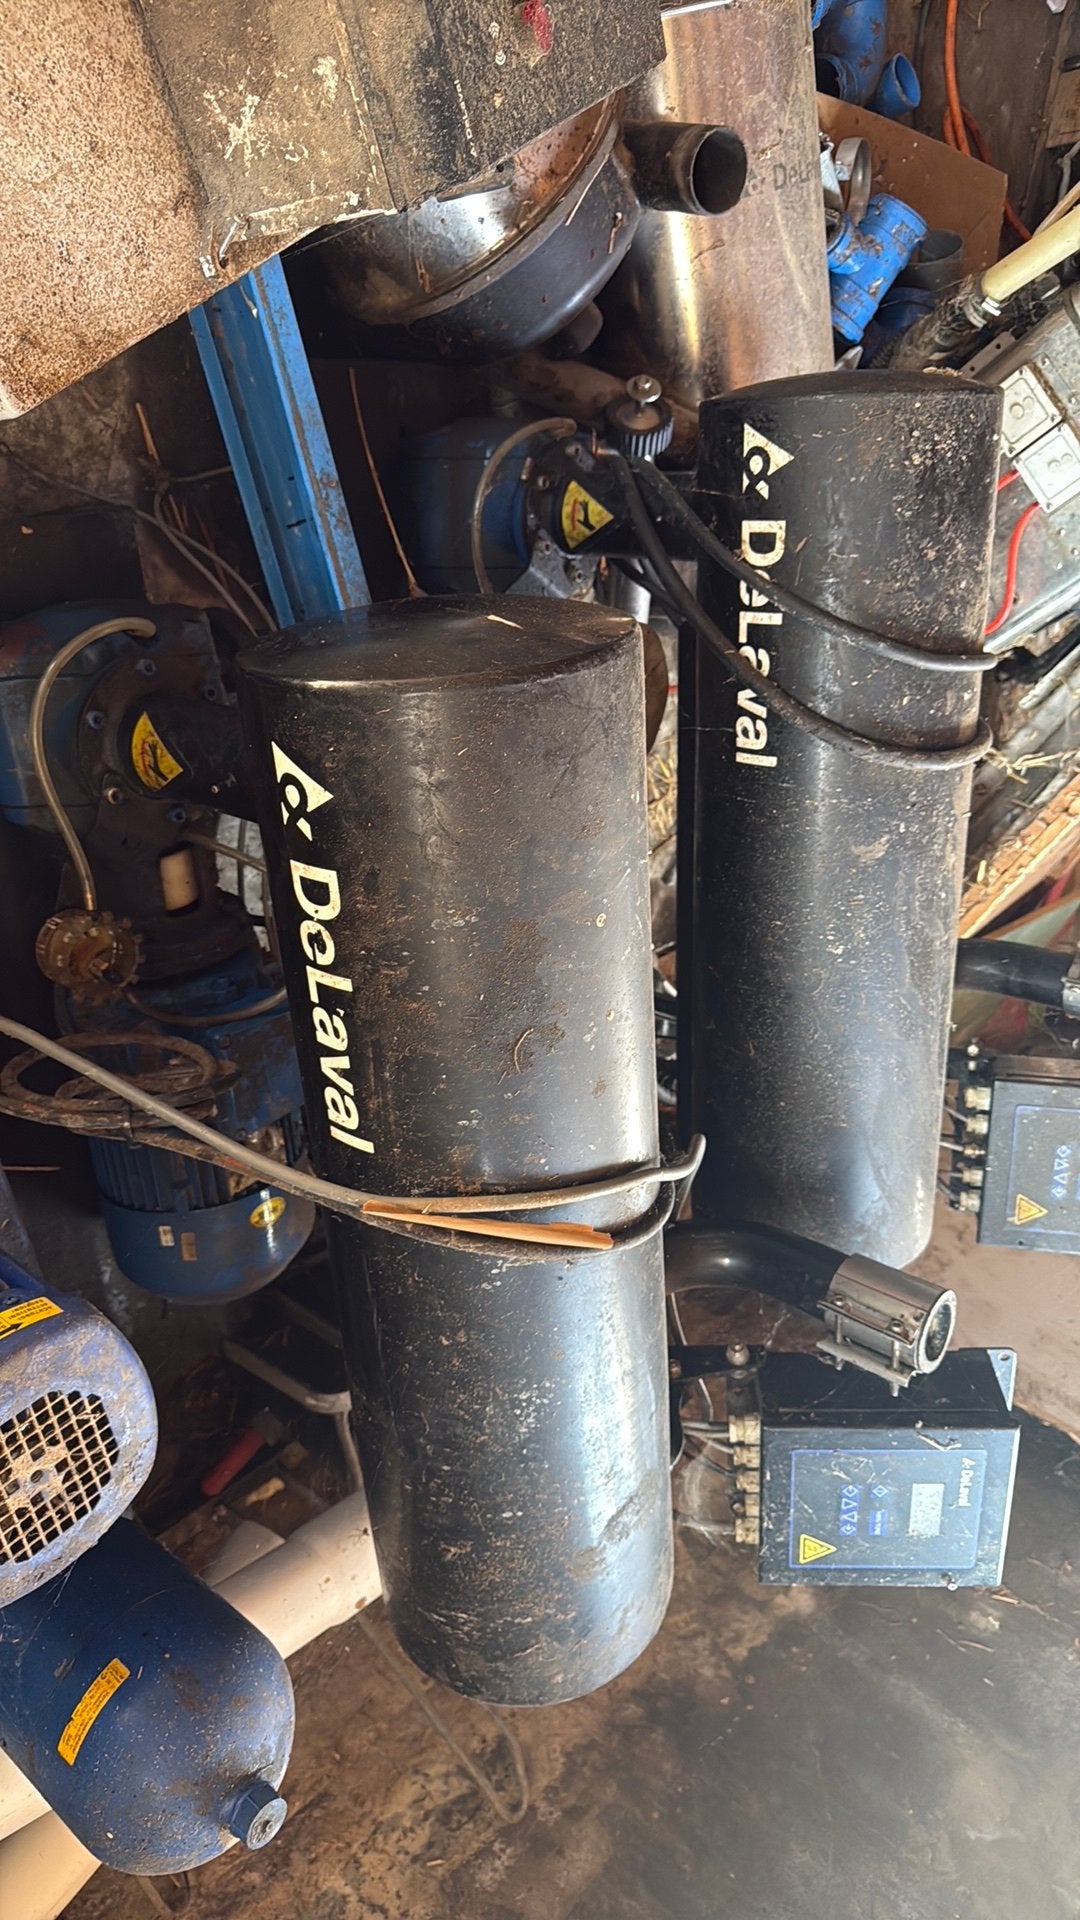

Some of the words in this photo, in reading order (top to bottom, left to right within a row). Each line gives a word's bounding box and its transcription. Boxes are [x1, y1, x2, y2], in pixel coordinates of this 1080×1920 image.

[453, 79, 473, 140] DeLaval
[289, 858, 375, 1154] DeLaval
[958, 1469, 974, 1507] DeLaval
